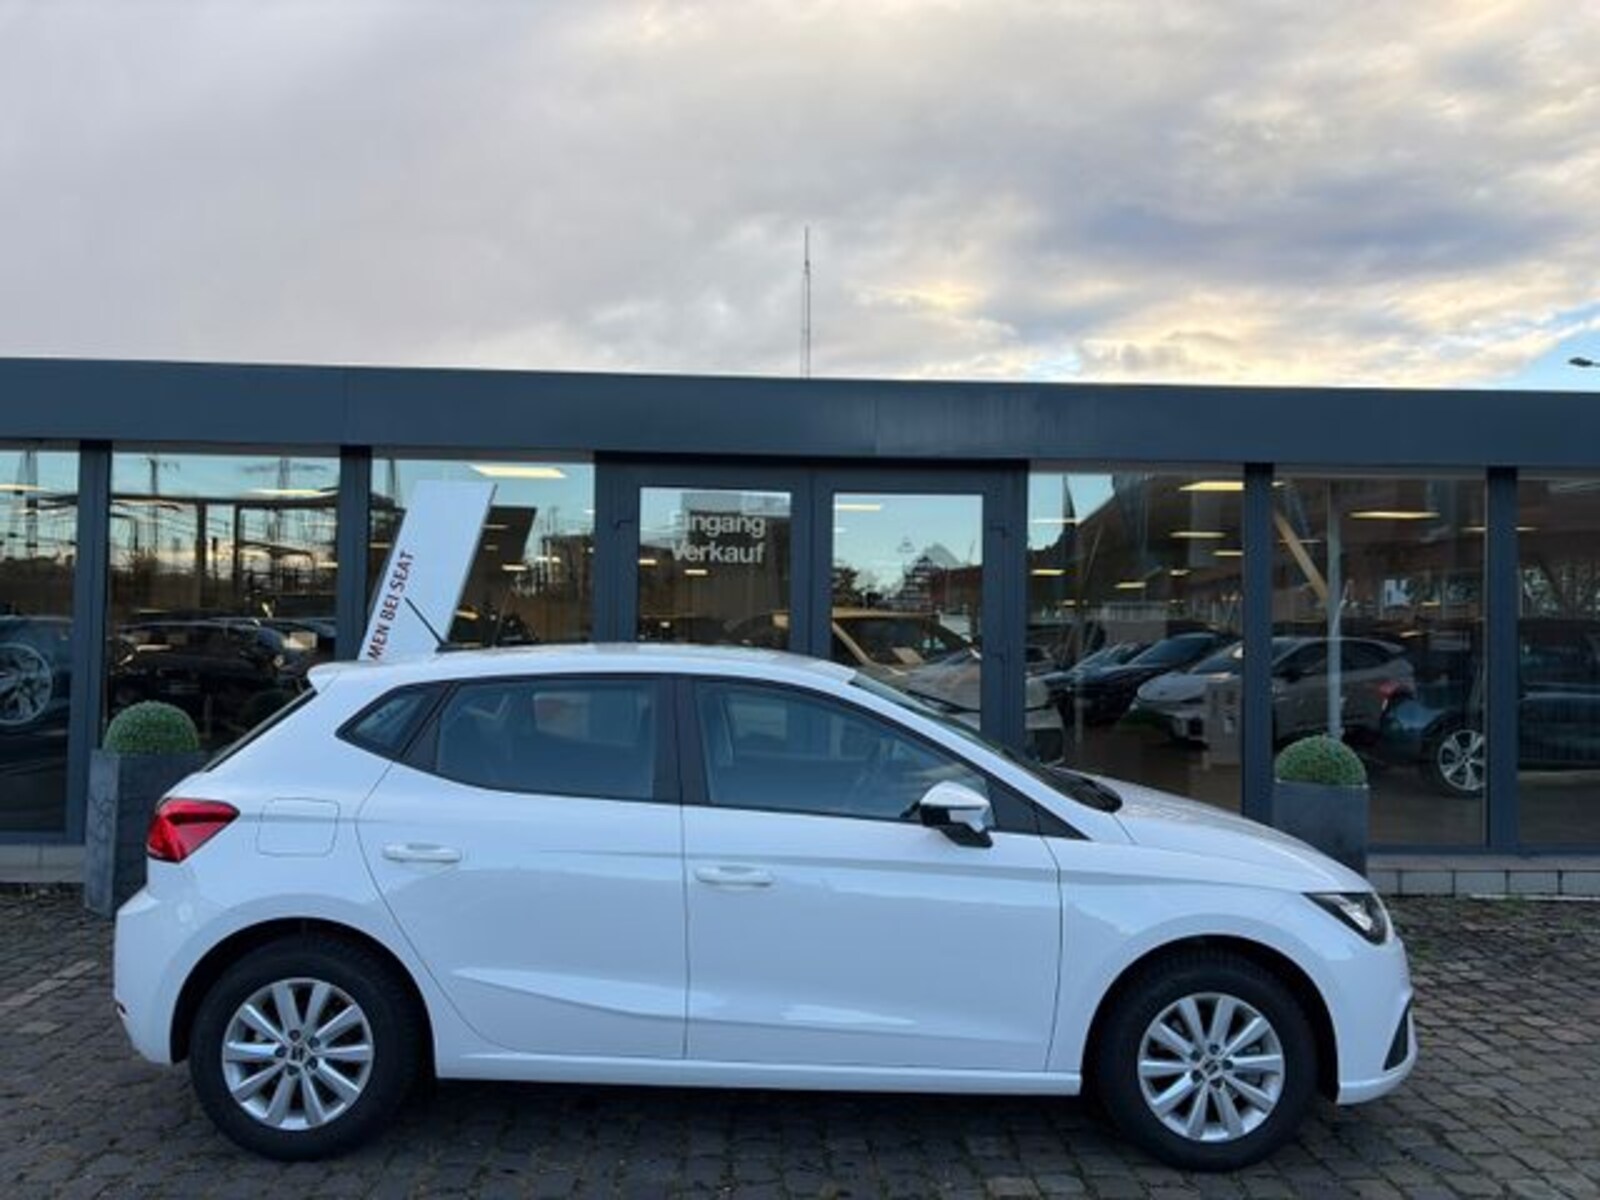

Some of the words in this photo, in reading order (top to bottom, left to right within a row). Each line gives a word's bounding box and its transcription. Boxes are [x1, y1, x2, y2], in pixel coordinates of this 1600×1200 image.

[671, 540, 765, 563] Verkauf
[389, 551, 415, 594] SEAT
[380, 593, 399, 621] BEI
[367, 622, 391, 661] MEN
